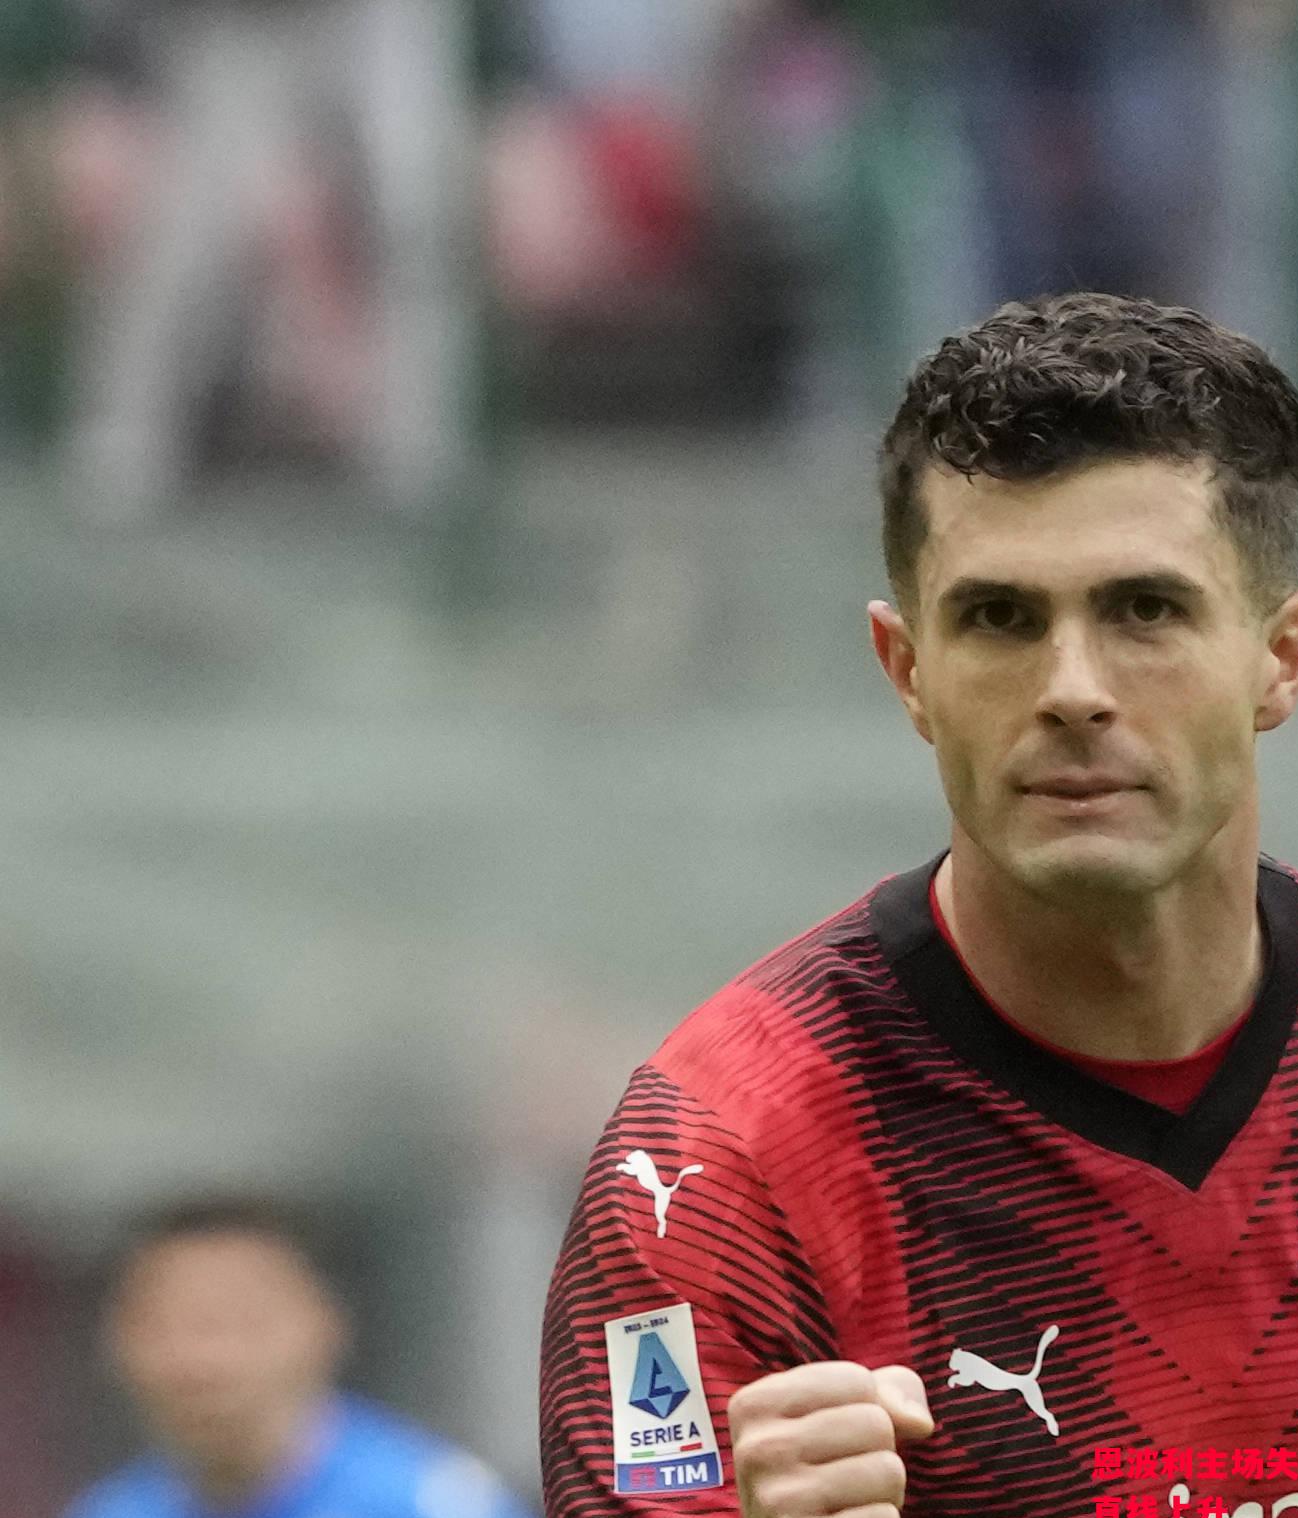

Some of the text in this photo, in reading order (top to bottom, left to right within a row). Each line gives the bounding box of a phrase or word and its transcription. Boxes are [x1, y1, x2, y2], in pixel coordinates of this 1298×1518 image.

[630, 1421, 700, 1447] SERIE A
[660, 1461, 708, 1486] TIM
